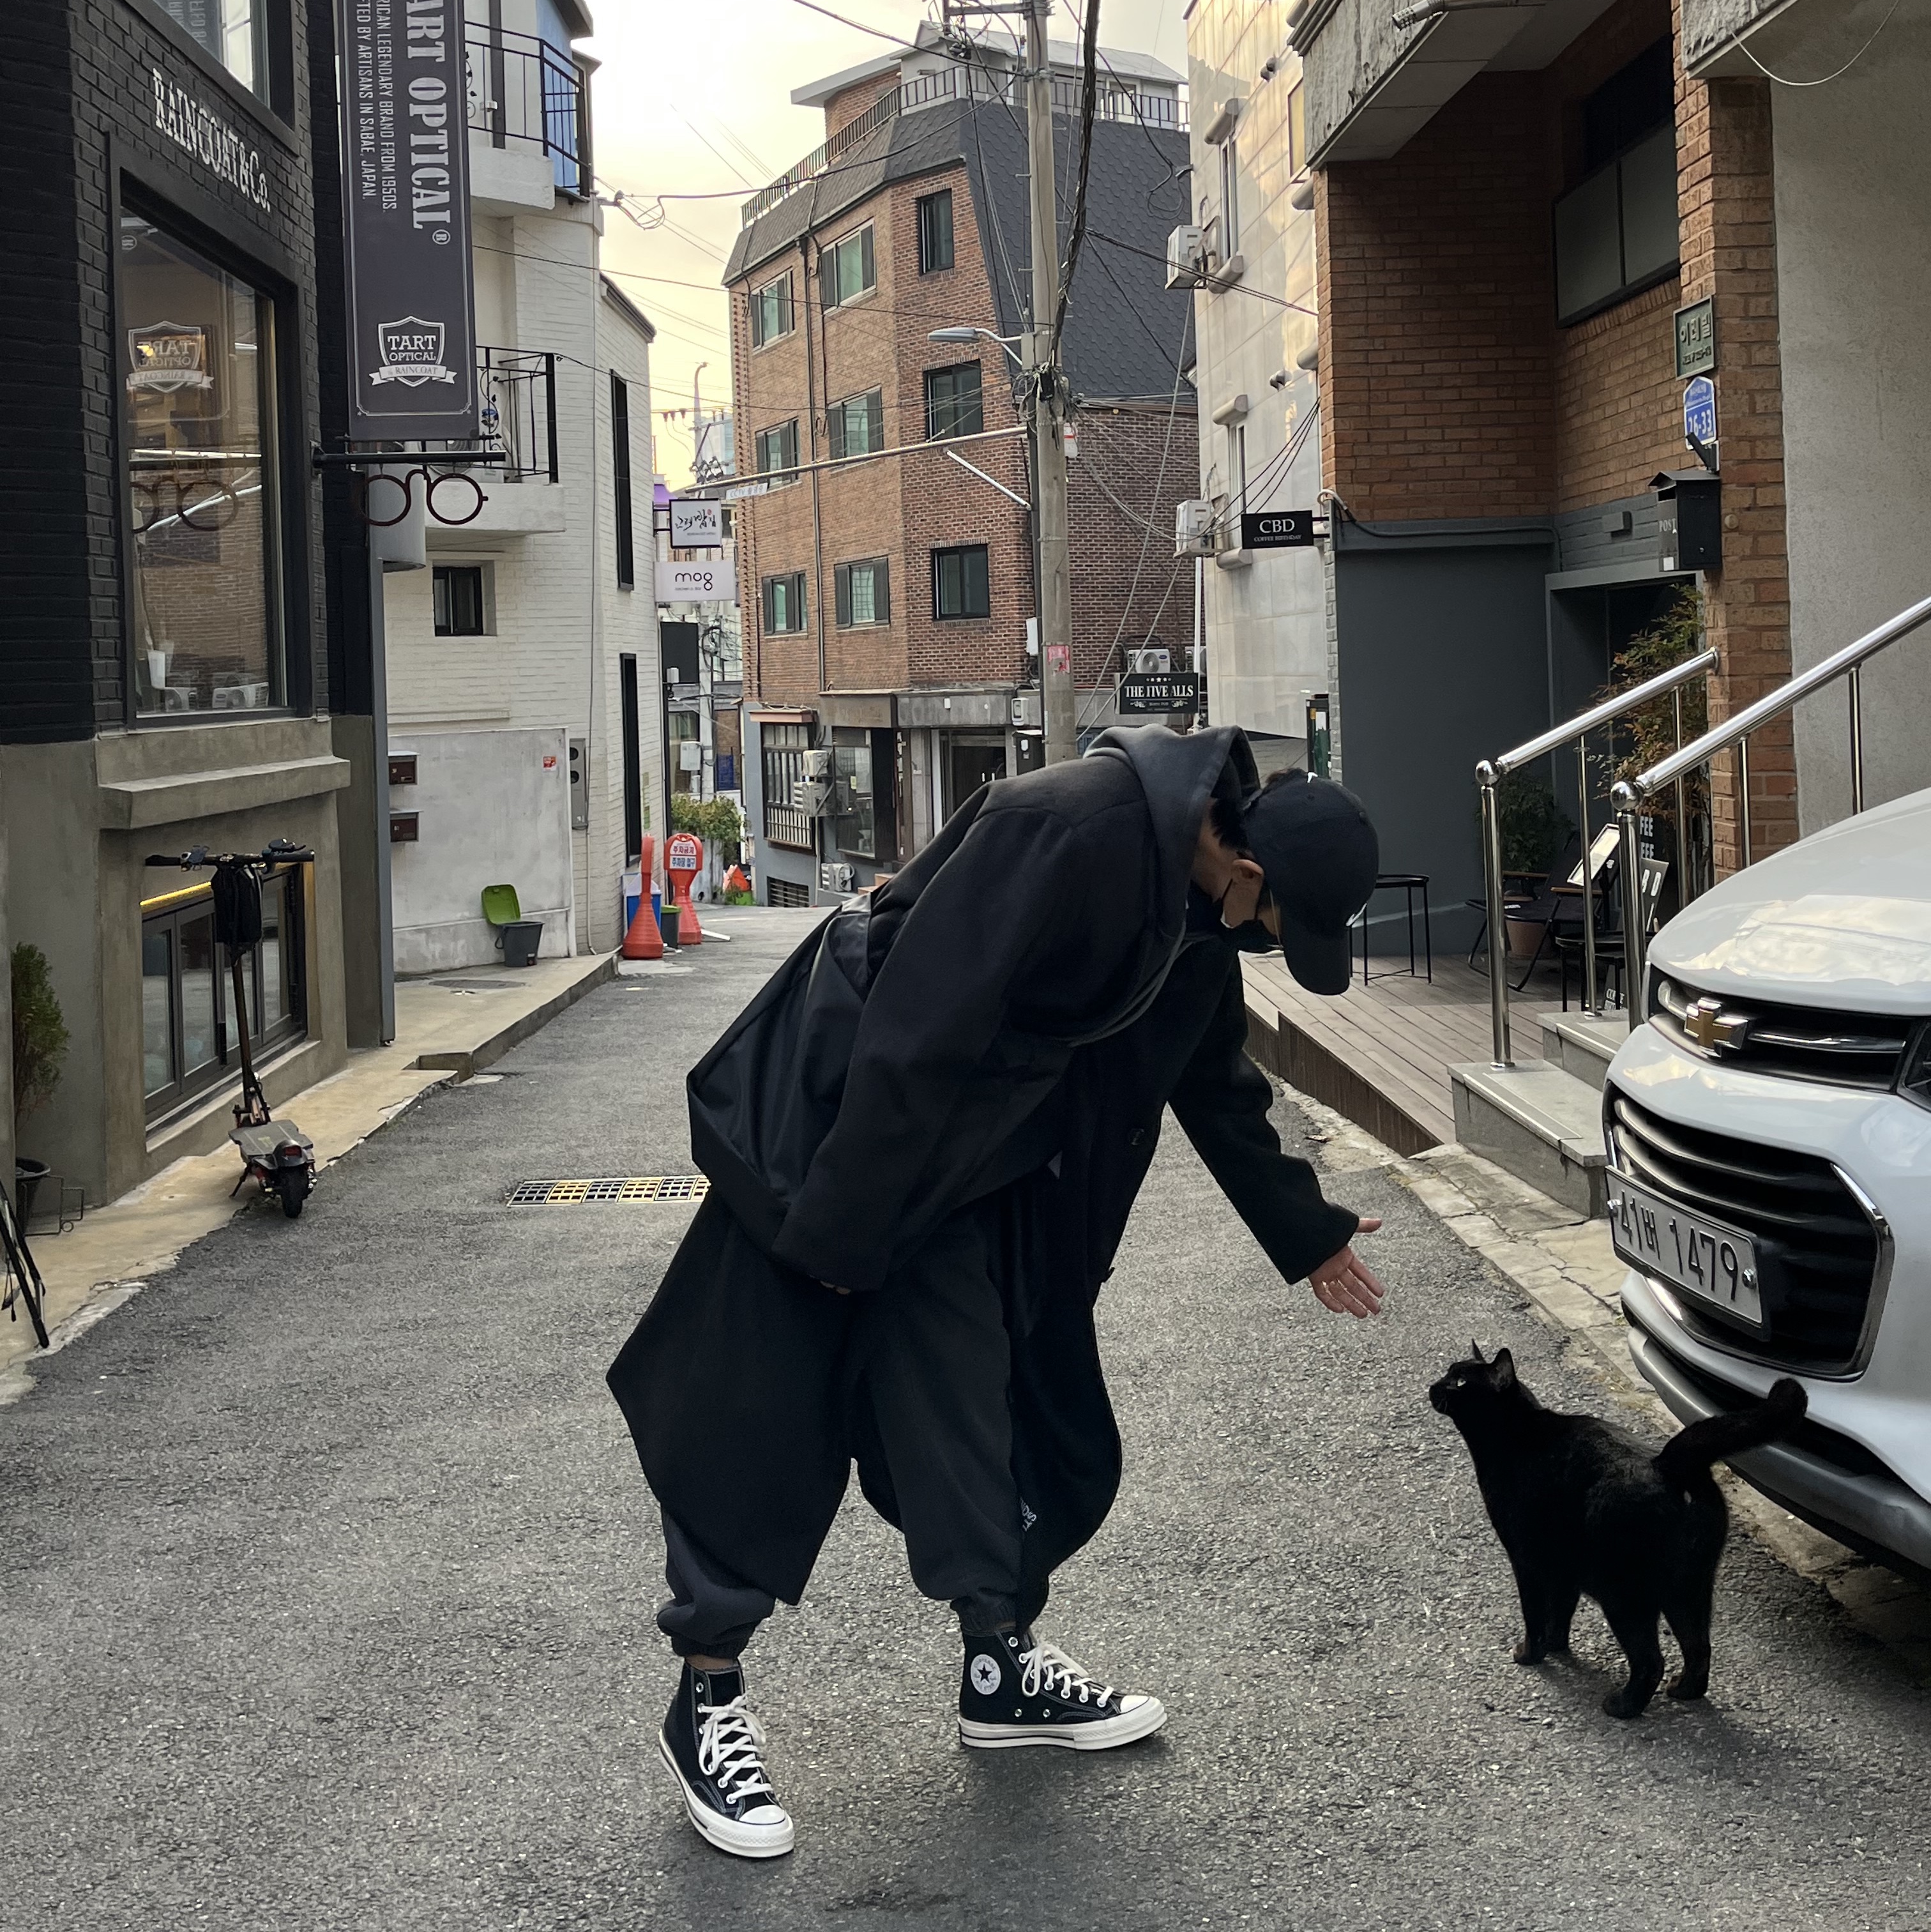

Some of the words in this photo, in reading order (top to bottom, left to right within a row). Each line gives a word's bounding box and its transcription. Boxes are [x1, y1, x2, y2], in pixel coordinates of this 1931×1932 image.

[356, 0, 371, 22] TED
[357, 27, 372, 40] BY
[358, 45, 374, 98] ARTISANS
[377, 34, 393, 96] LEGENDARY
[360, 103, 374, 114] IN
[379, 101, 395, 138] BRAND
[360, 118, 375, 156] SABAE,
[381, 142, 396, 172] FROM
[408, 77, 451, 229] OPTICAL
[361, 160, 377, 201] JAPAN.
[387, 335, 437, 350] TART
[388, 352, 437, 361] OPTICAL
[395, 366, 438, 375] RAINCOAT
[1259, 519, 1295, 533] CBD
[1659, 518, 1676, 532] POST
[675, 572, 713, 591] mog
[1124, 685, 1144, 697] THE
[1146, 685, 1169, 697] FIVE
[1621, 1189, 1661, 1262] 41버
[1669, 1216, 1739, 1302] 1479
